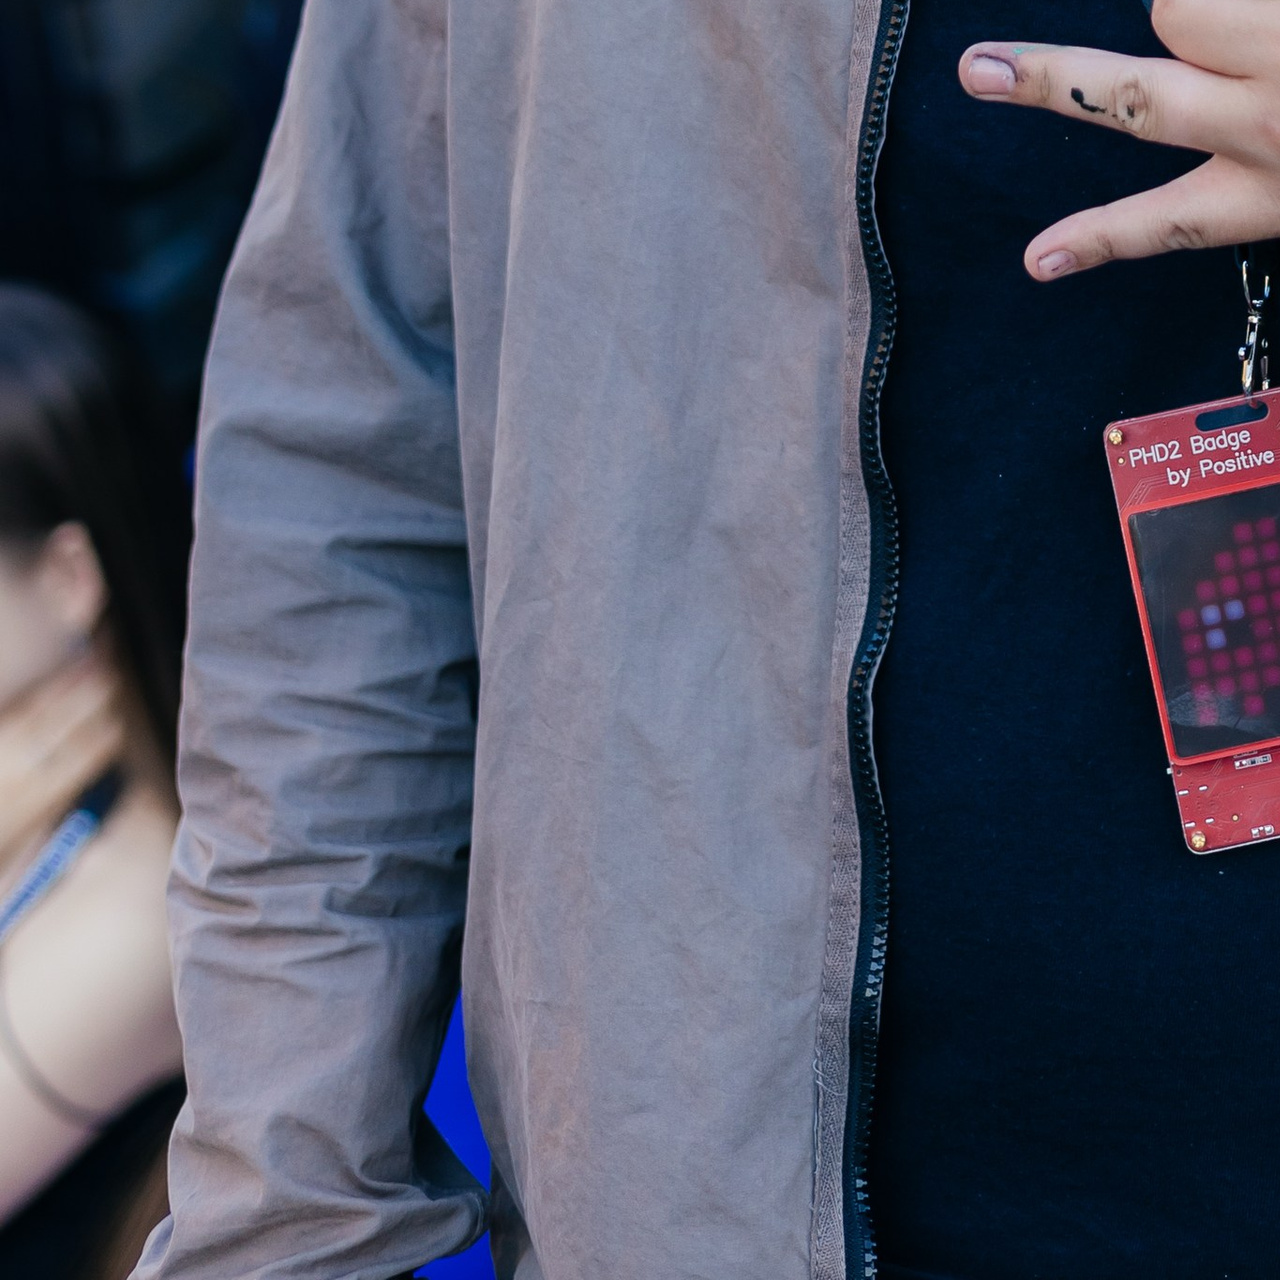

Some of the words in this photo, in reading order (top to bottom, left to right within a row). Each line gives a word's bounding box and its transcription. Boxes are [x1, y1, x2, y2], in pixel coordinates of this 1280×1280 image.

[1129, 440, 1183, 468] PHD2
[1189, 429, 1251, 455] Badge
[1166, 467, 1191, 488] by
[1199, 448, 1275, 478] Positive
